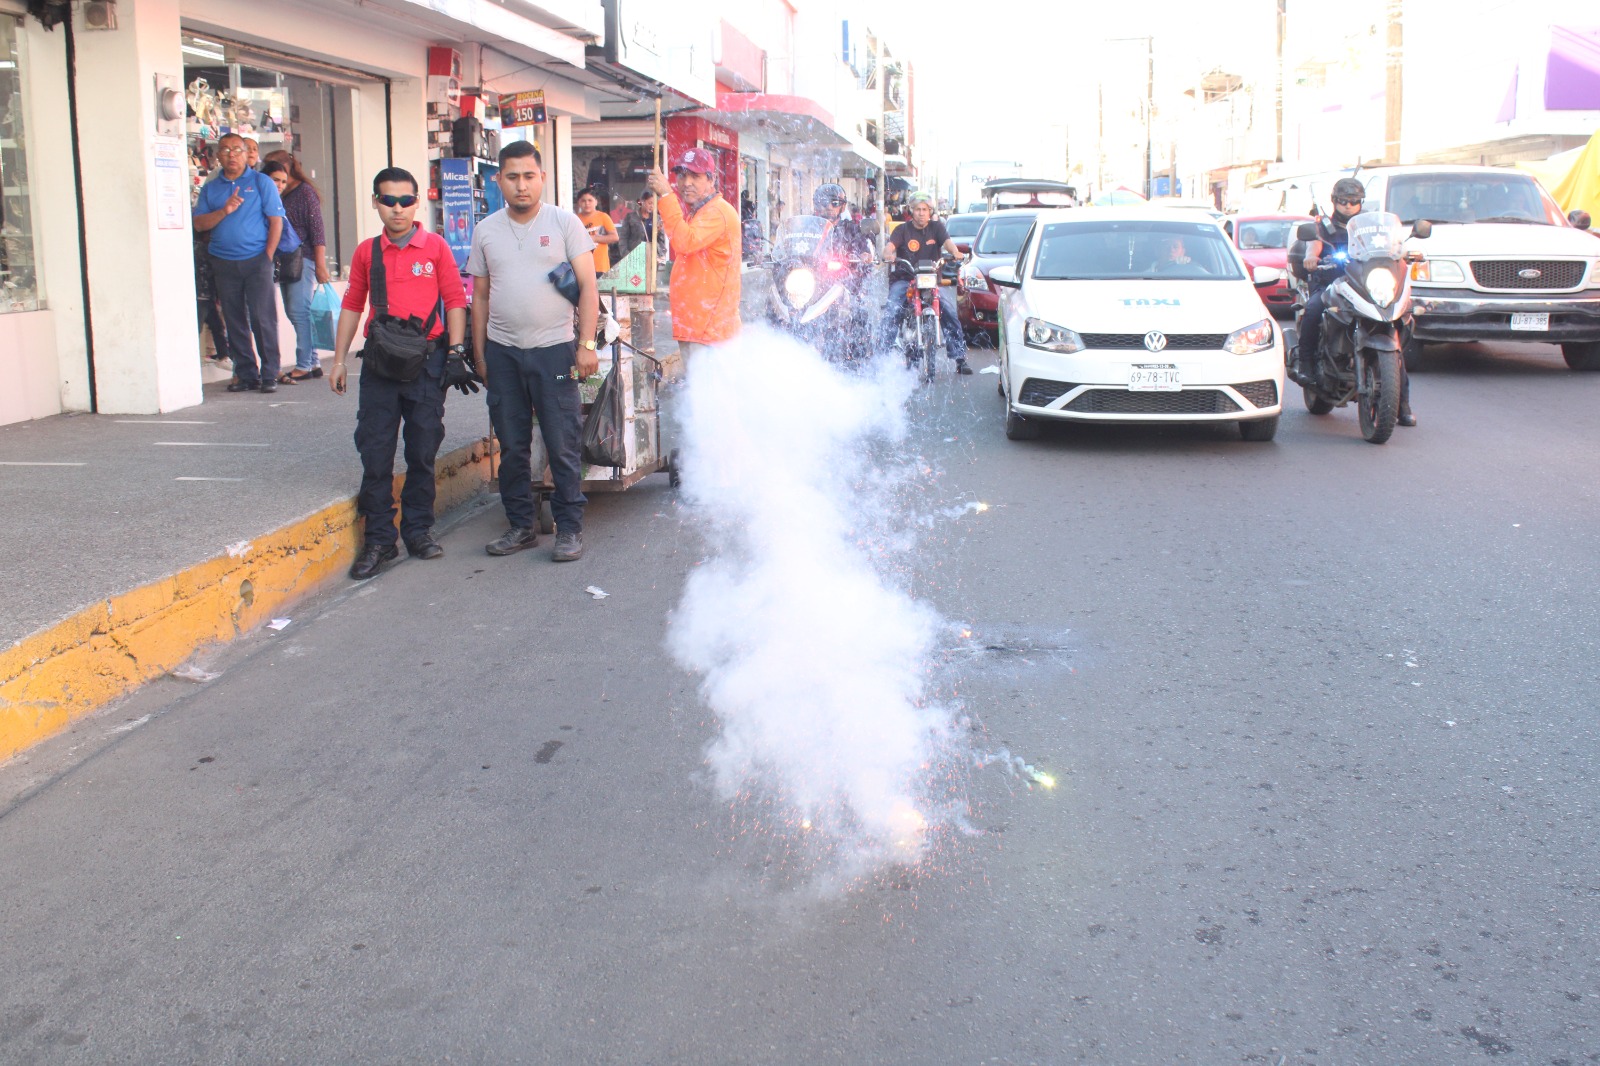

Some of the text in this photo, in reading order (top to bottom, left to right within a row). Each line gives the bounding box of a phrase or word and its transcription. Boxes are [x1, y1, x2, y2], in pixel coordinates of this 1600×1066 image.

[443, 172, 469, 180] Micas
[1117, 298, 1181, 306] TAXI
[1131, 372, 1180, 383] 69-78-TVC
